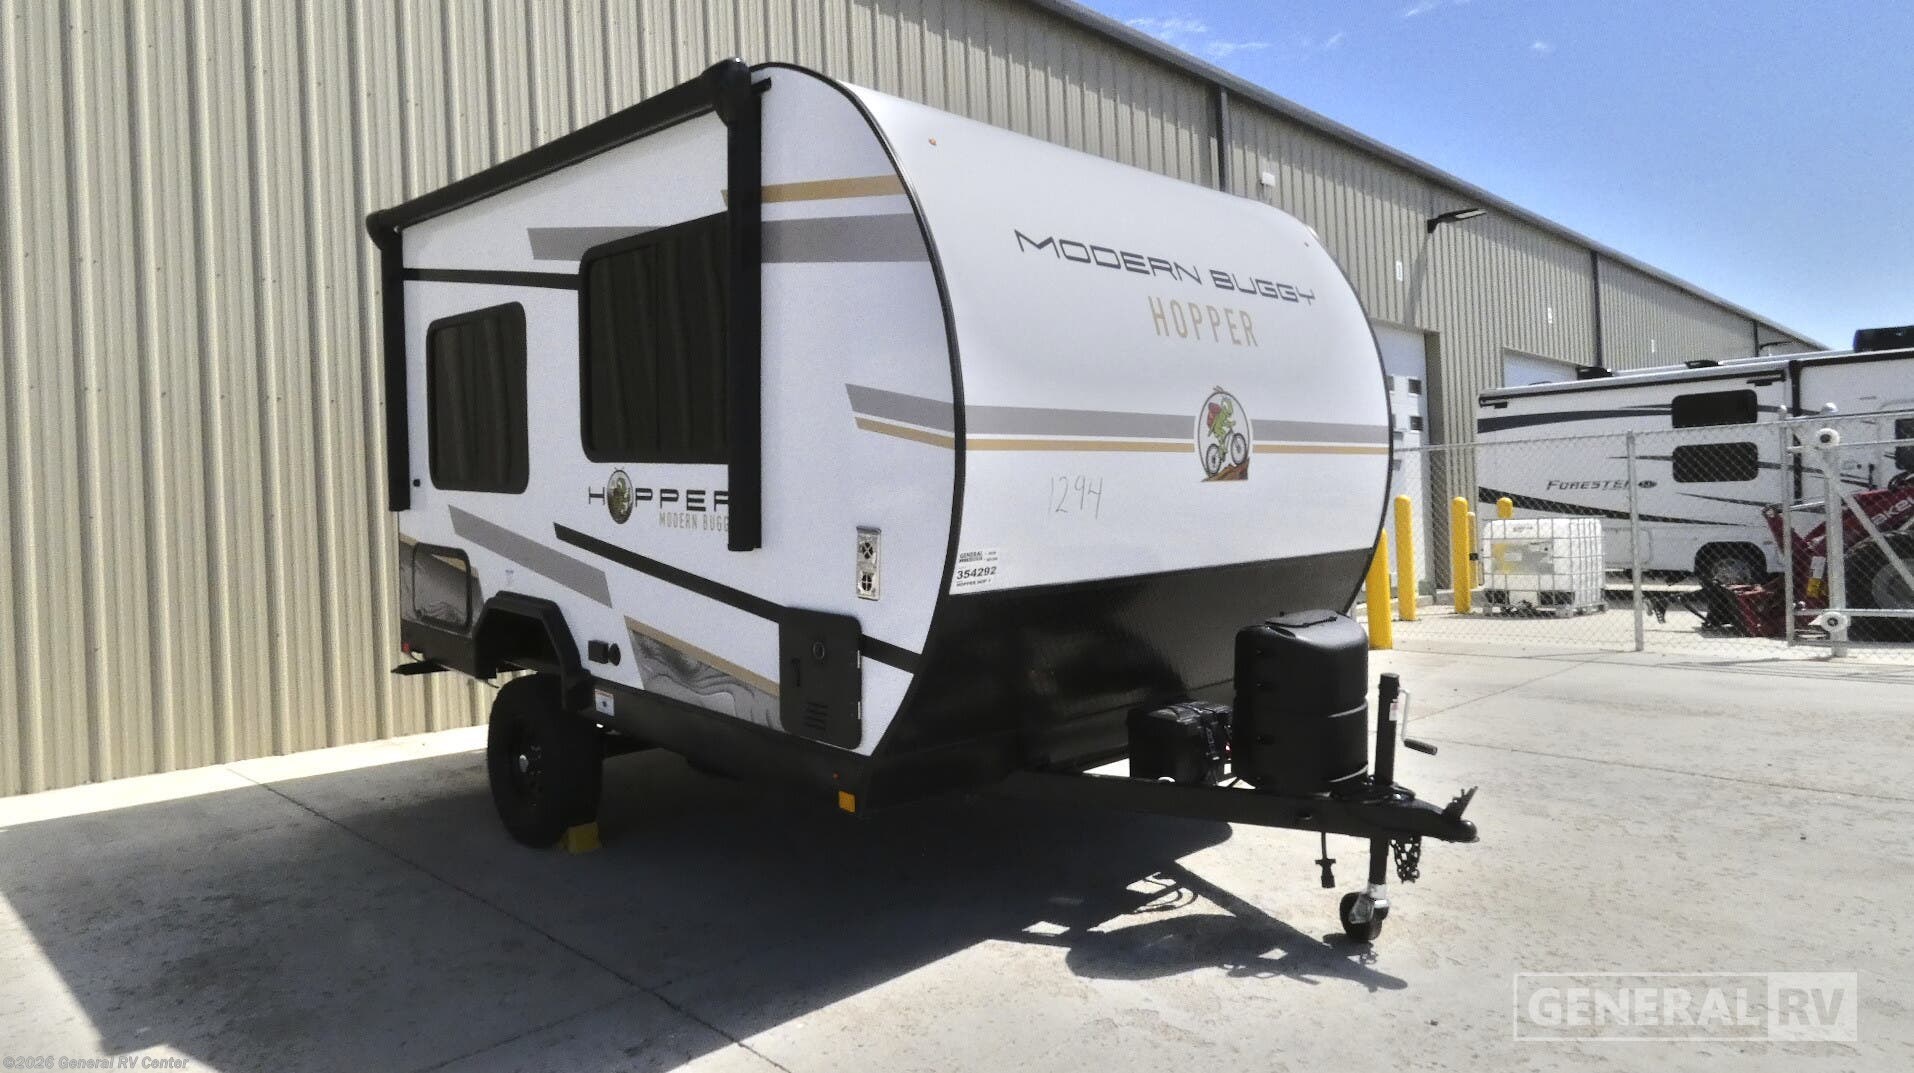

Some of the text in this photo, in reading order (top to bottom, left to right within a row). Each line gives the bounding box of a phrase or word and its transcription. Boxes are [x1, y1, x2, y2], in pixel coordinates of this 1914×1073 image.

[1014, 229, 1316, 305] MODERN BUGGY
[1148, 295, 1258, 347] HOPPER
[1048, 475, 1103, 520] 1294
[658, 512, 729, 532] MODERN BUGG
[956, 566, 996, 580] 354292
